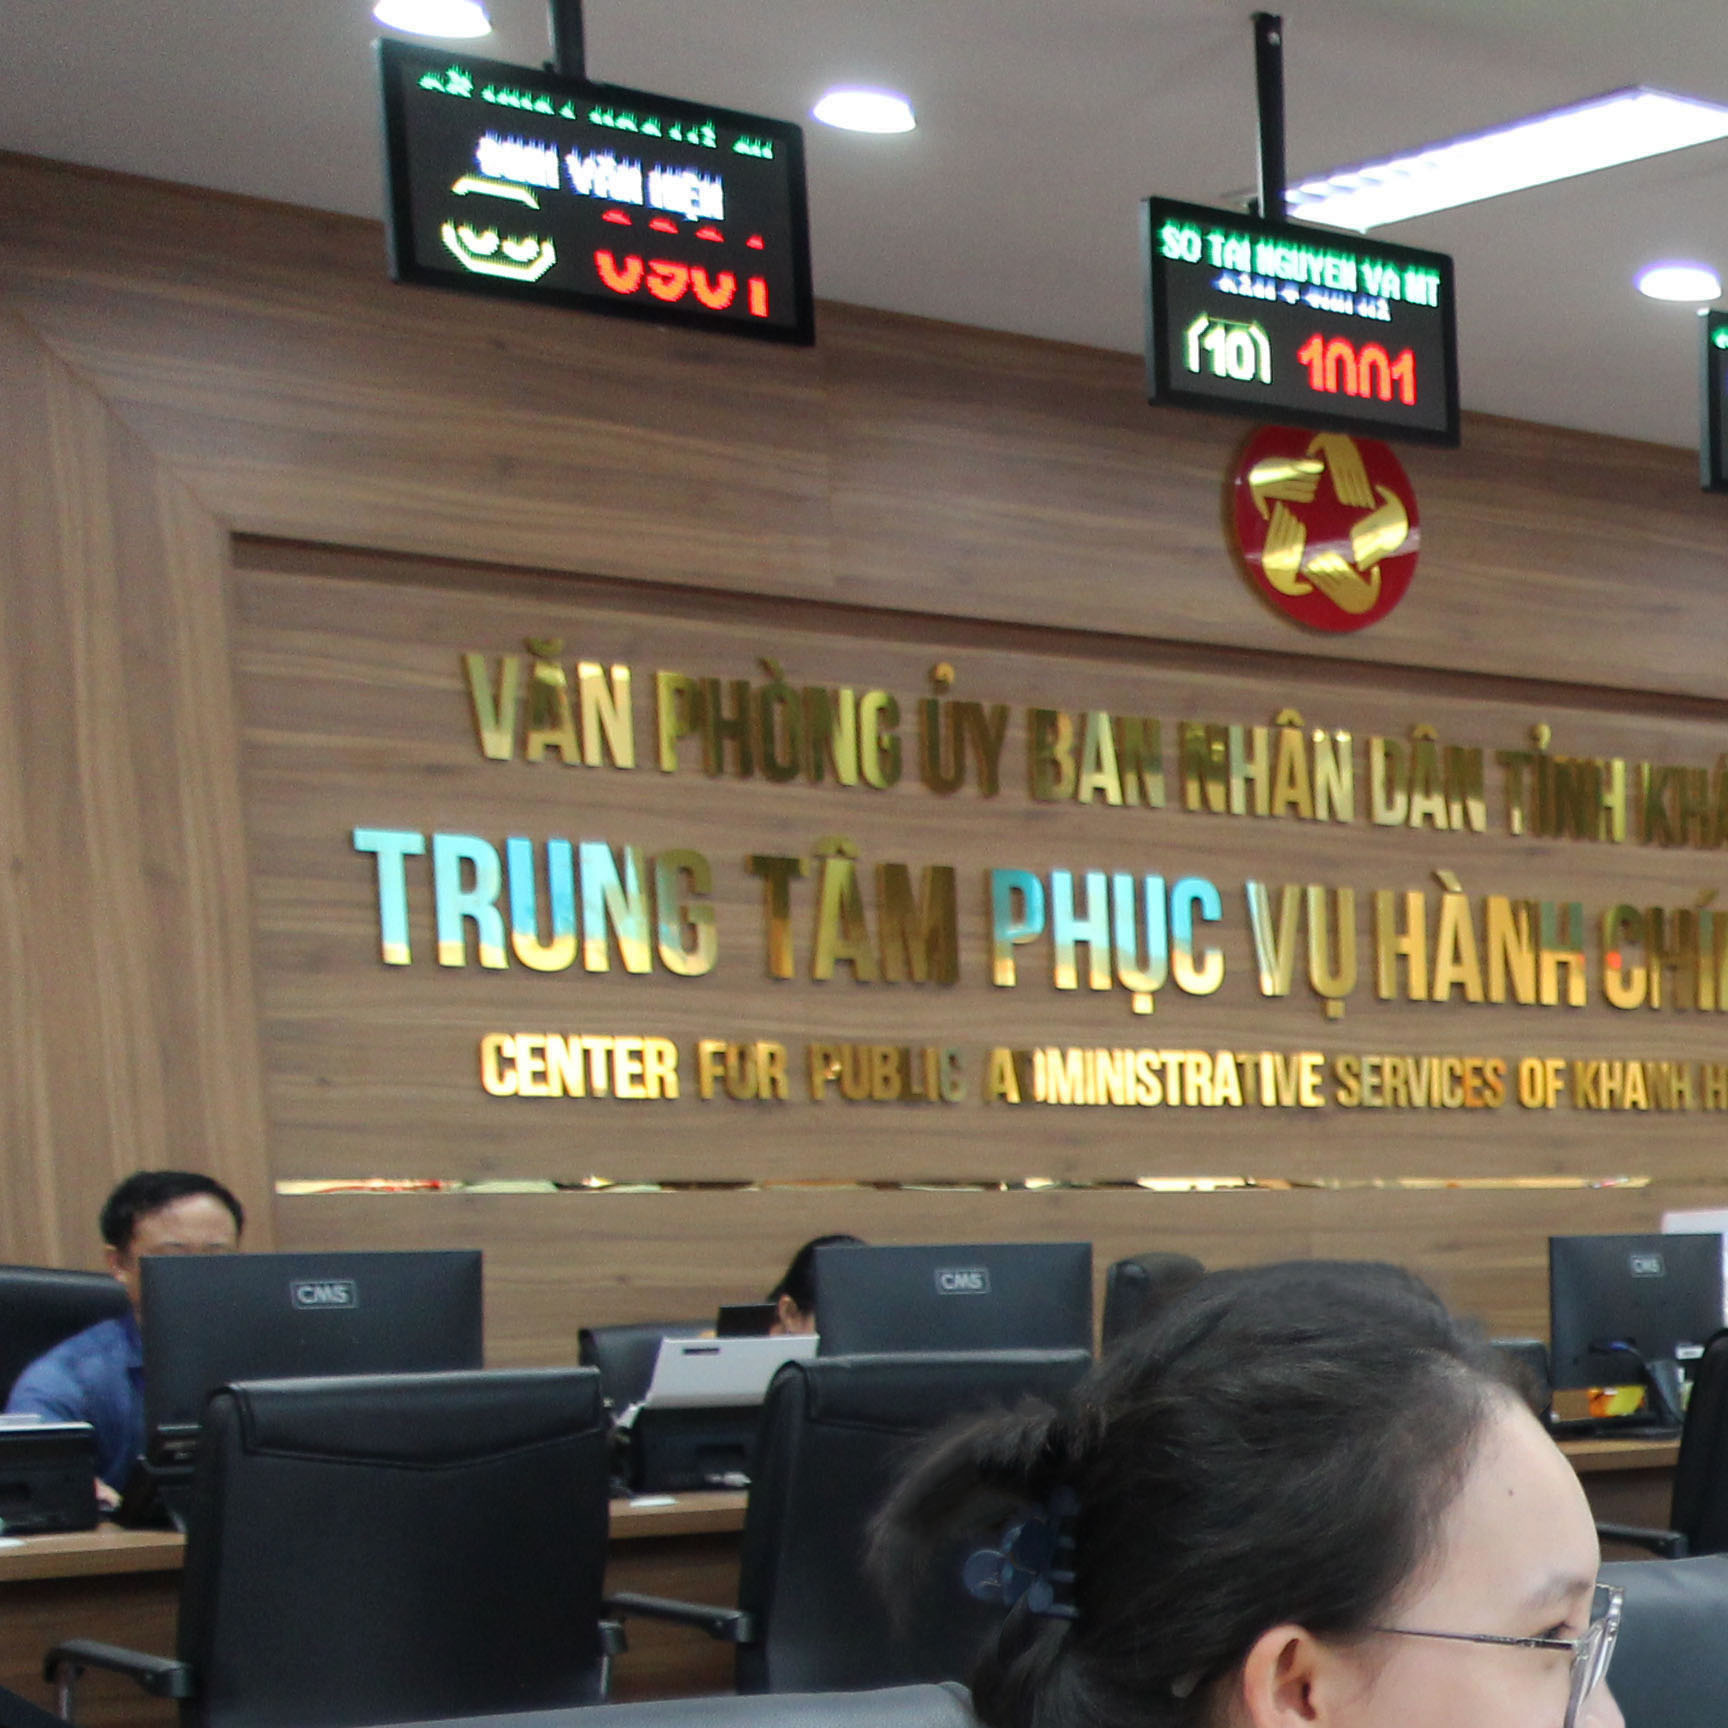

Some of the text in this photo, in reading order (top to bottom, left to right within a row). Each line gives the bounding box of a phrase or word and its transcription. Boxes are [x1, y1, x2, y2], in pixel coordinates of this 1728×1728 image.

[462, 636, 635, 769] VĂN
[655, 657, 900, 790] PHÒNG
[920, 662, 1010, 799] ỦY
[1027, 707, 1166, 809] BAN
[1179, 707, 1355, 824] NHÂN
[1368, 724, 1487, 833] DÂN
[1495, 722, 1627, 843] TỈNH
[353, 827, 720, 978] TRUNG
[743, 835, 960, 985] TÂM
[988, 868, 1225, 1016] PHỤC
[1245, 879, 1358, 1020] VỤ
[1376, 870, 1587, 1008] HÀNH
[480, 1032, 679, 1100] CENTER
[699, 1039, 789, 1102] FOR
[808, 1041, 967, 1103] PUBLIC
[1336, 1053, 1507, 1110] SERVICES
[1518, 1057, 1566, 1110] OF
[1575, 1060, 1695, 1113] KHANH
[299, 1284, 350, 1305] CMS
[941, 1271, 983, 1291] CMS
